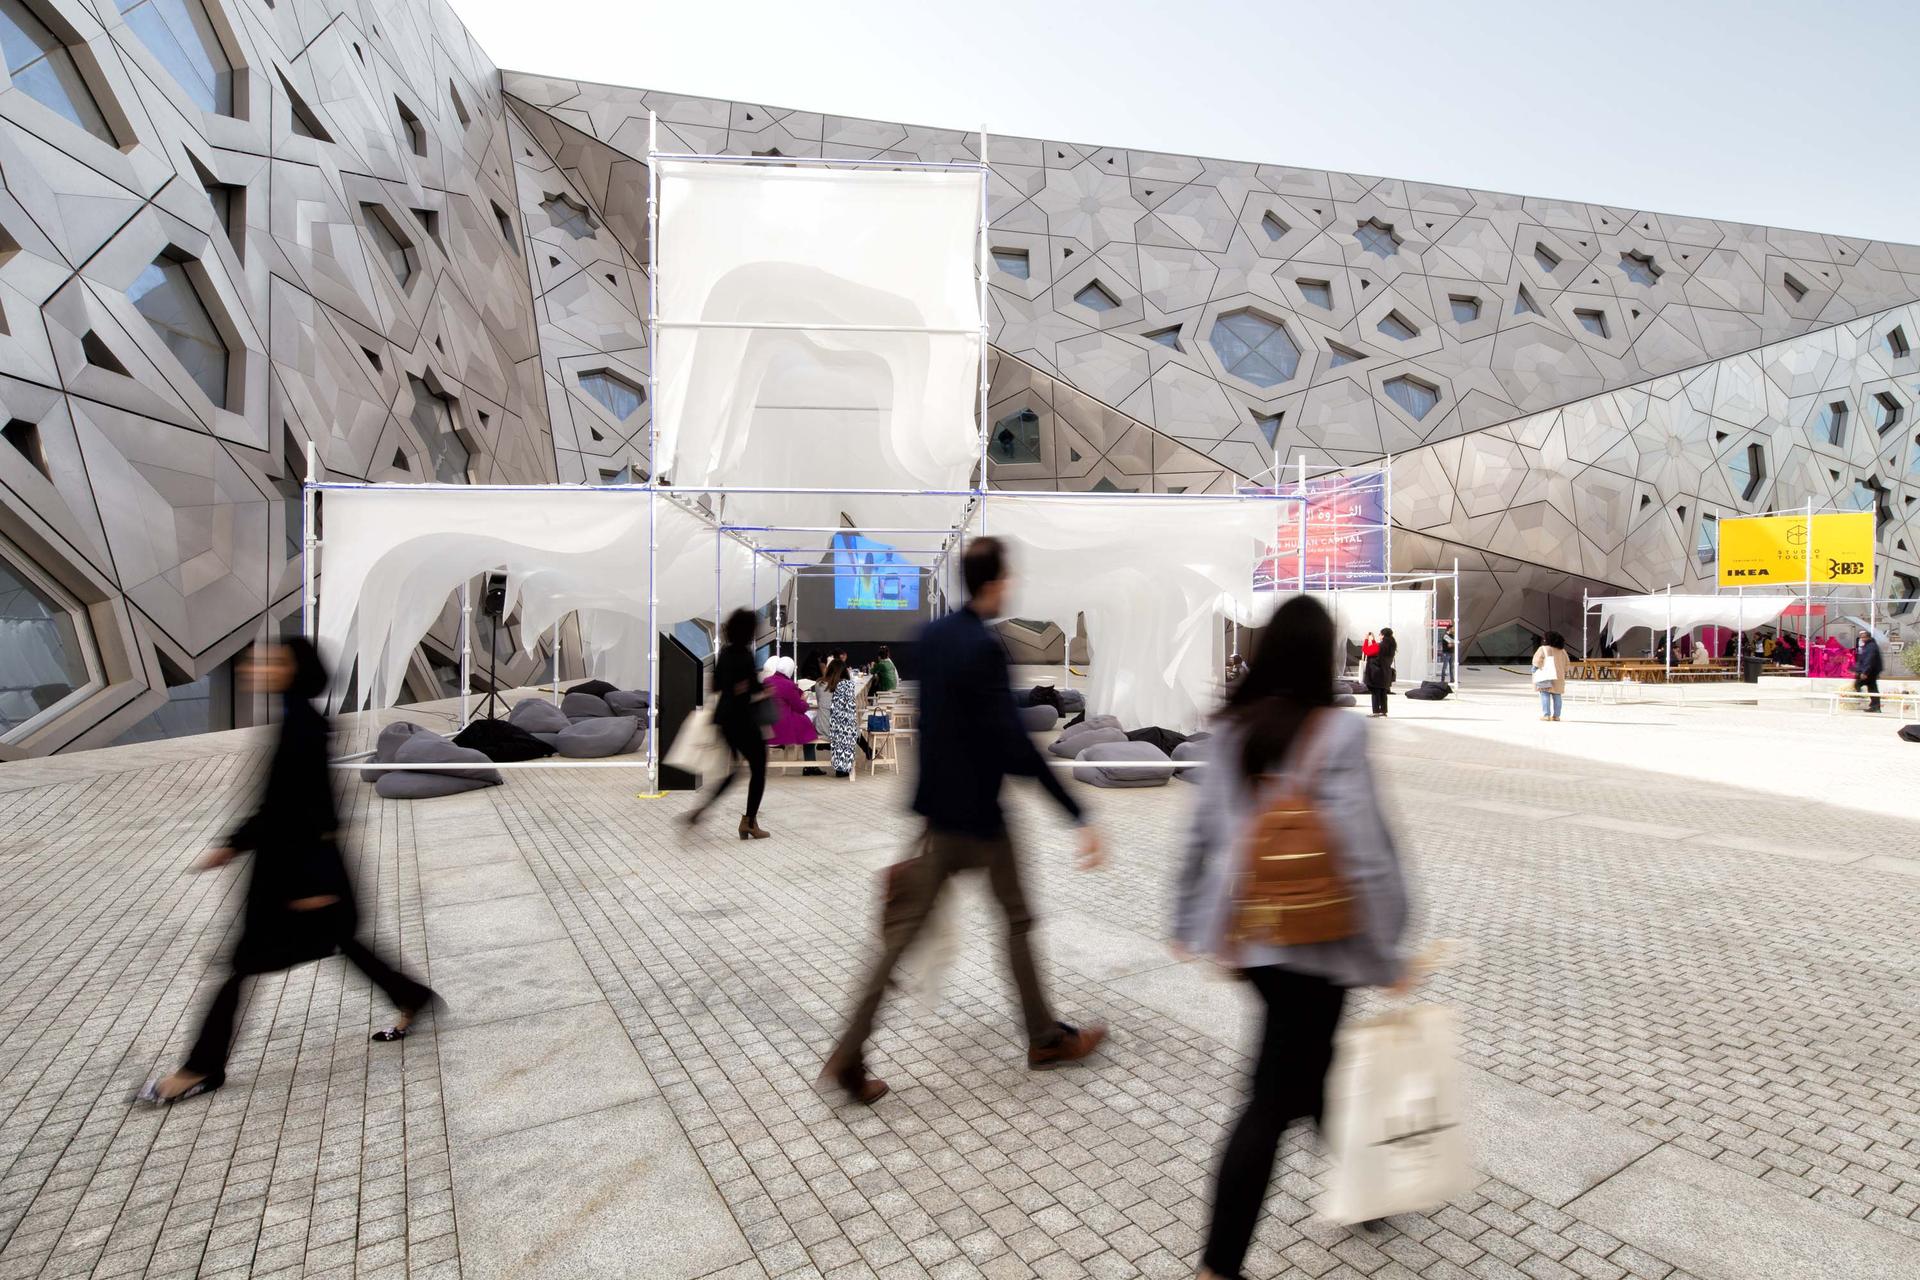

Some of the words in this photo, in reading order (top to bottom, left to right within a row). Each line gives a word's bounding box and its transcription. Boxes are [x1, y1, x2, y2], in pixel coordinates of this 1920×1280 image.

[1284, 539, 1318, 548] HUAN
[1321, 535, 1363, 546] CAPITAL
[1727, 568, 1770, 577] IKEA
